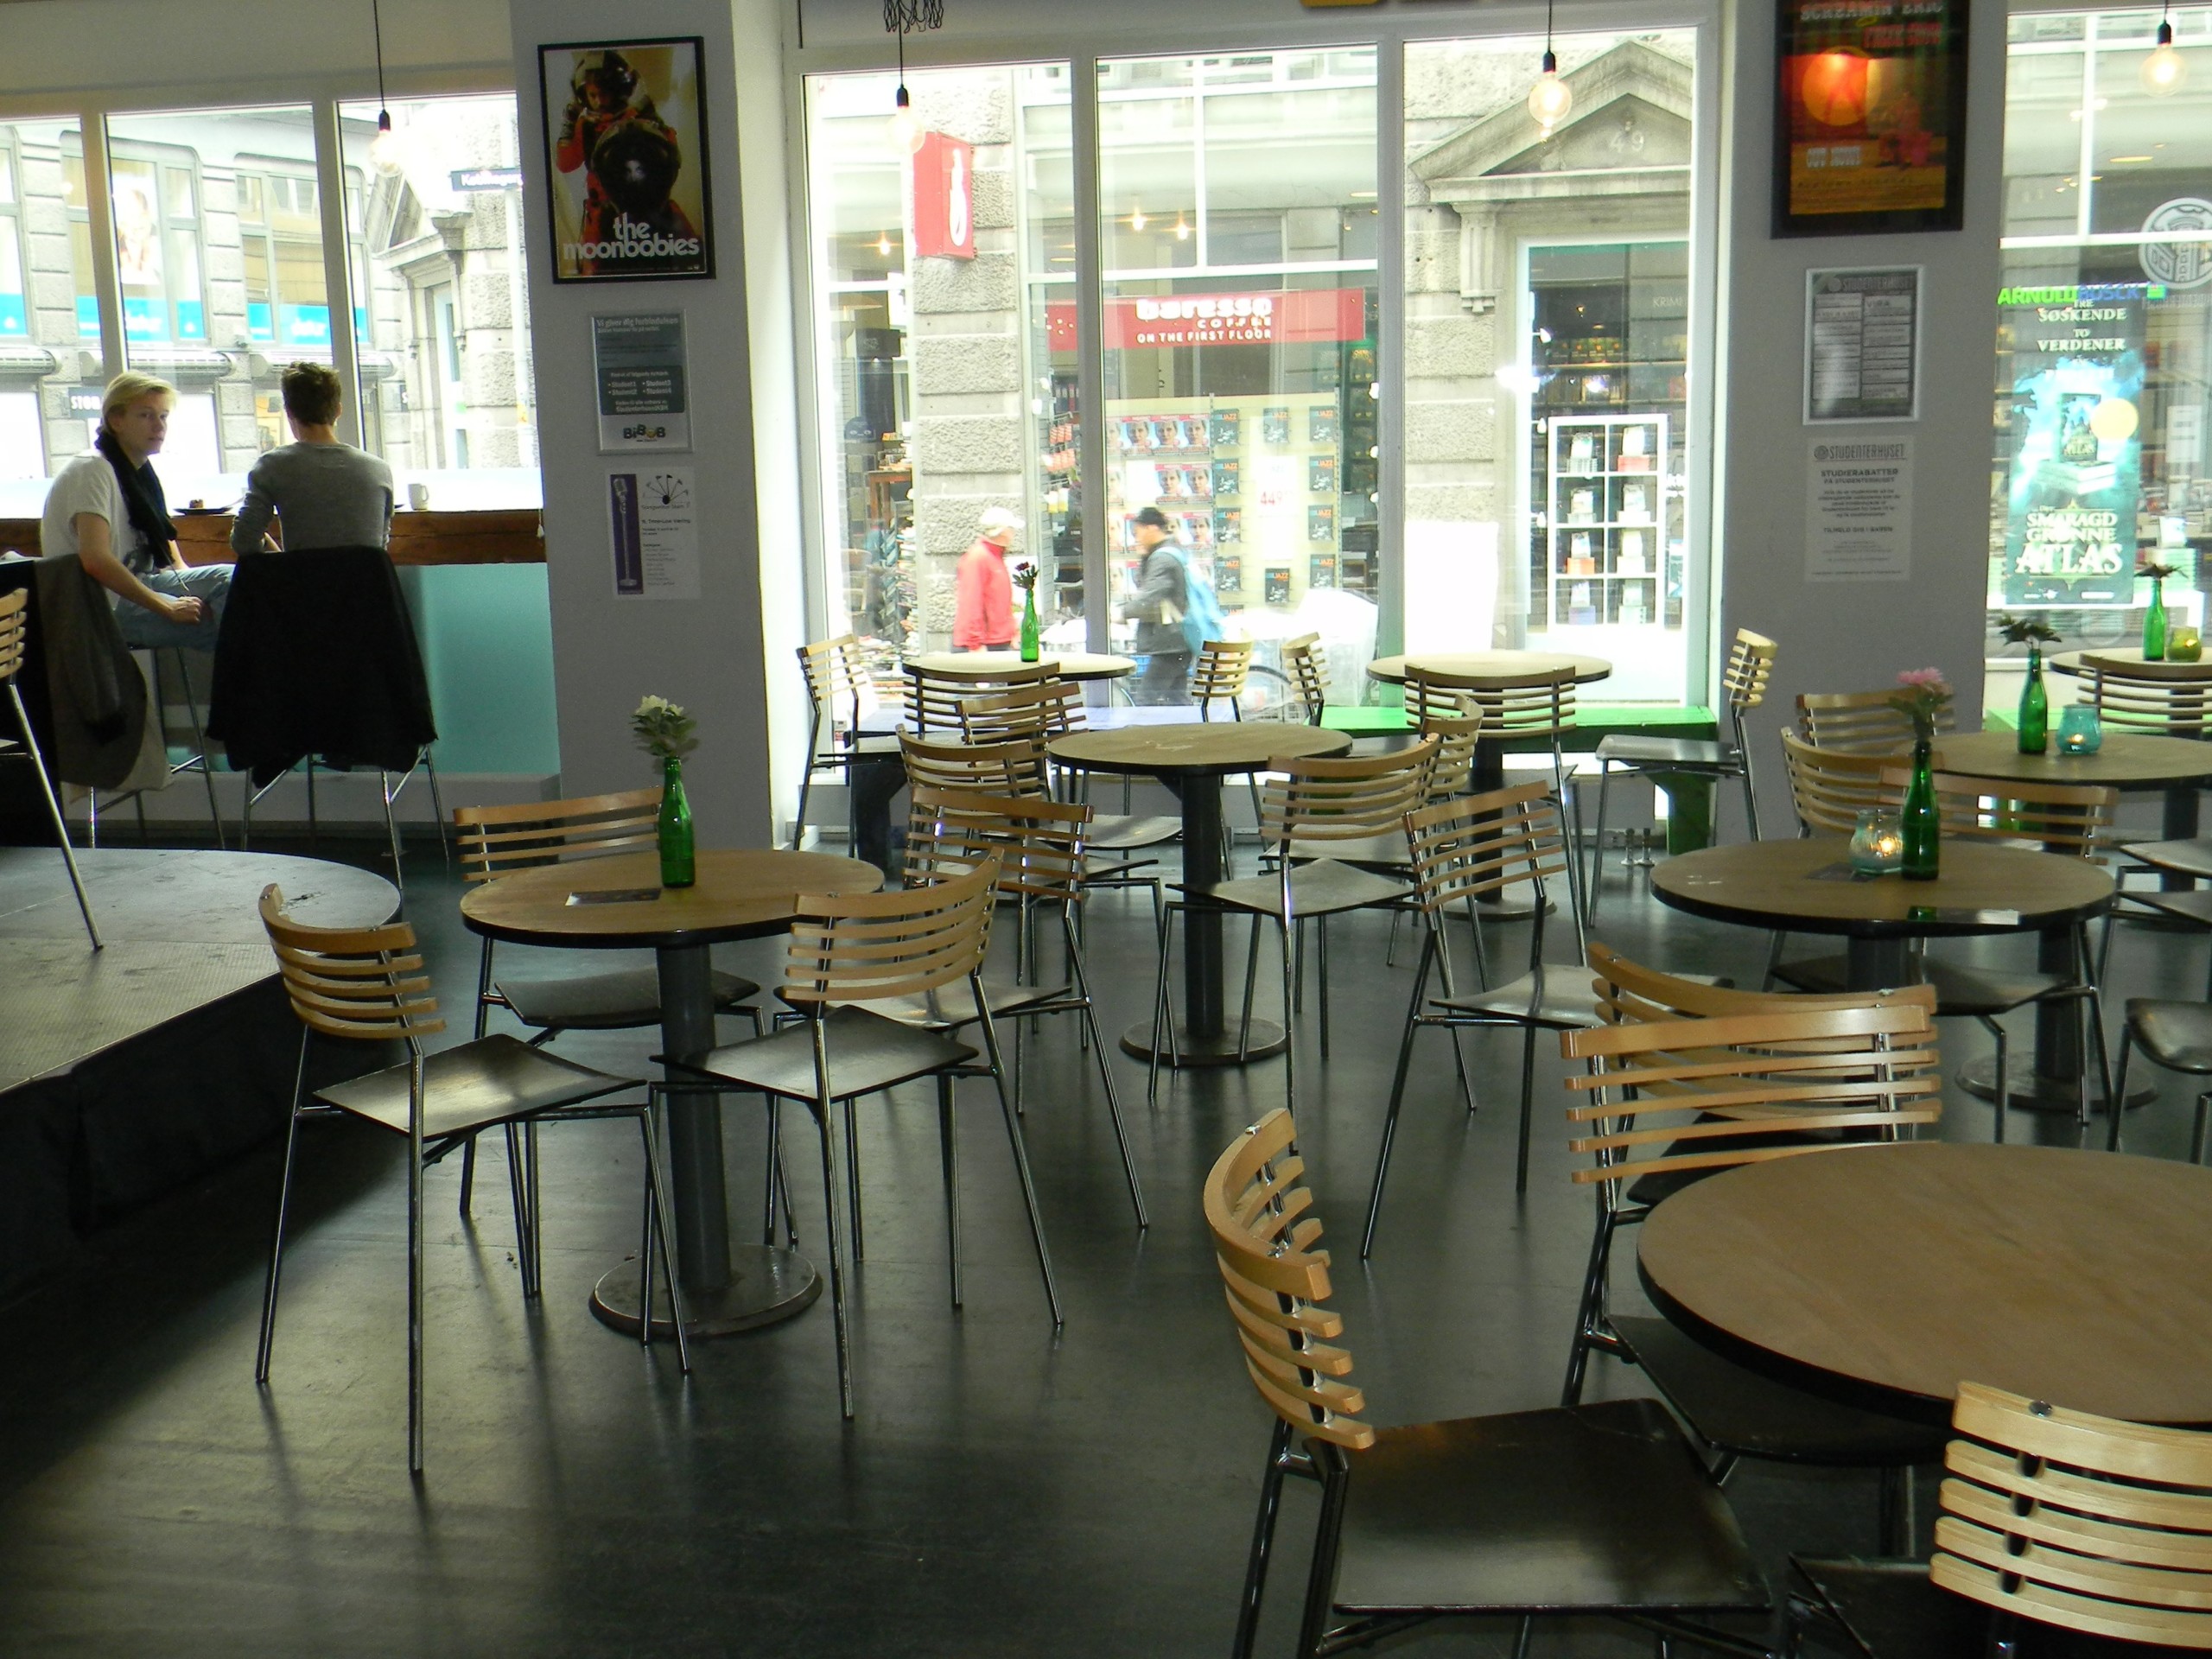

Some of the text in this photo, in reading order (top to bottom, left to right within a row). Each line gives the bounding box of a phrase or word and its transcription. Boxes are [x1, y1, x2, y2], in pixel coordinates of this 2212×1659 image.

[1609, 130, 1644, 153] 49
[613, 213, 650, 243] the
[1997, 287, 2079, 304] ARNOLD
[1135, 296, 1273, 321] baresso
[2037, 308, 2127, 322] SØSKENDE
[1196, 316, 1272, 329] COFFEE
[1136, 329, 1272, 344] ON THE FIRST FLOOR
[2073, 328, 2091, 338] TO
[2037, 338, 2126, 353] VERDENER
[2027, 512, 2119, 527] SMARAGD
[2015, 543, 2123, 574] ATLAS
